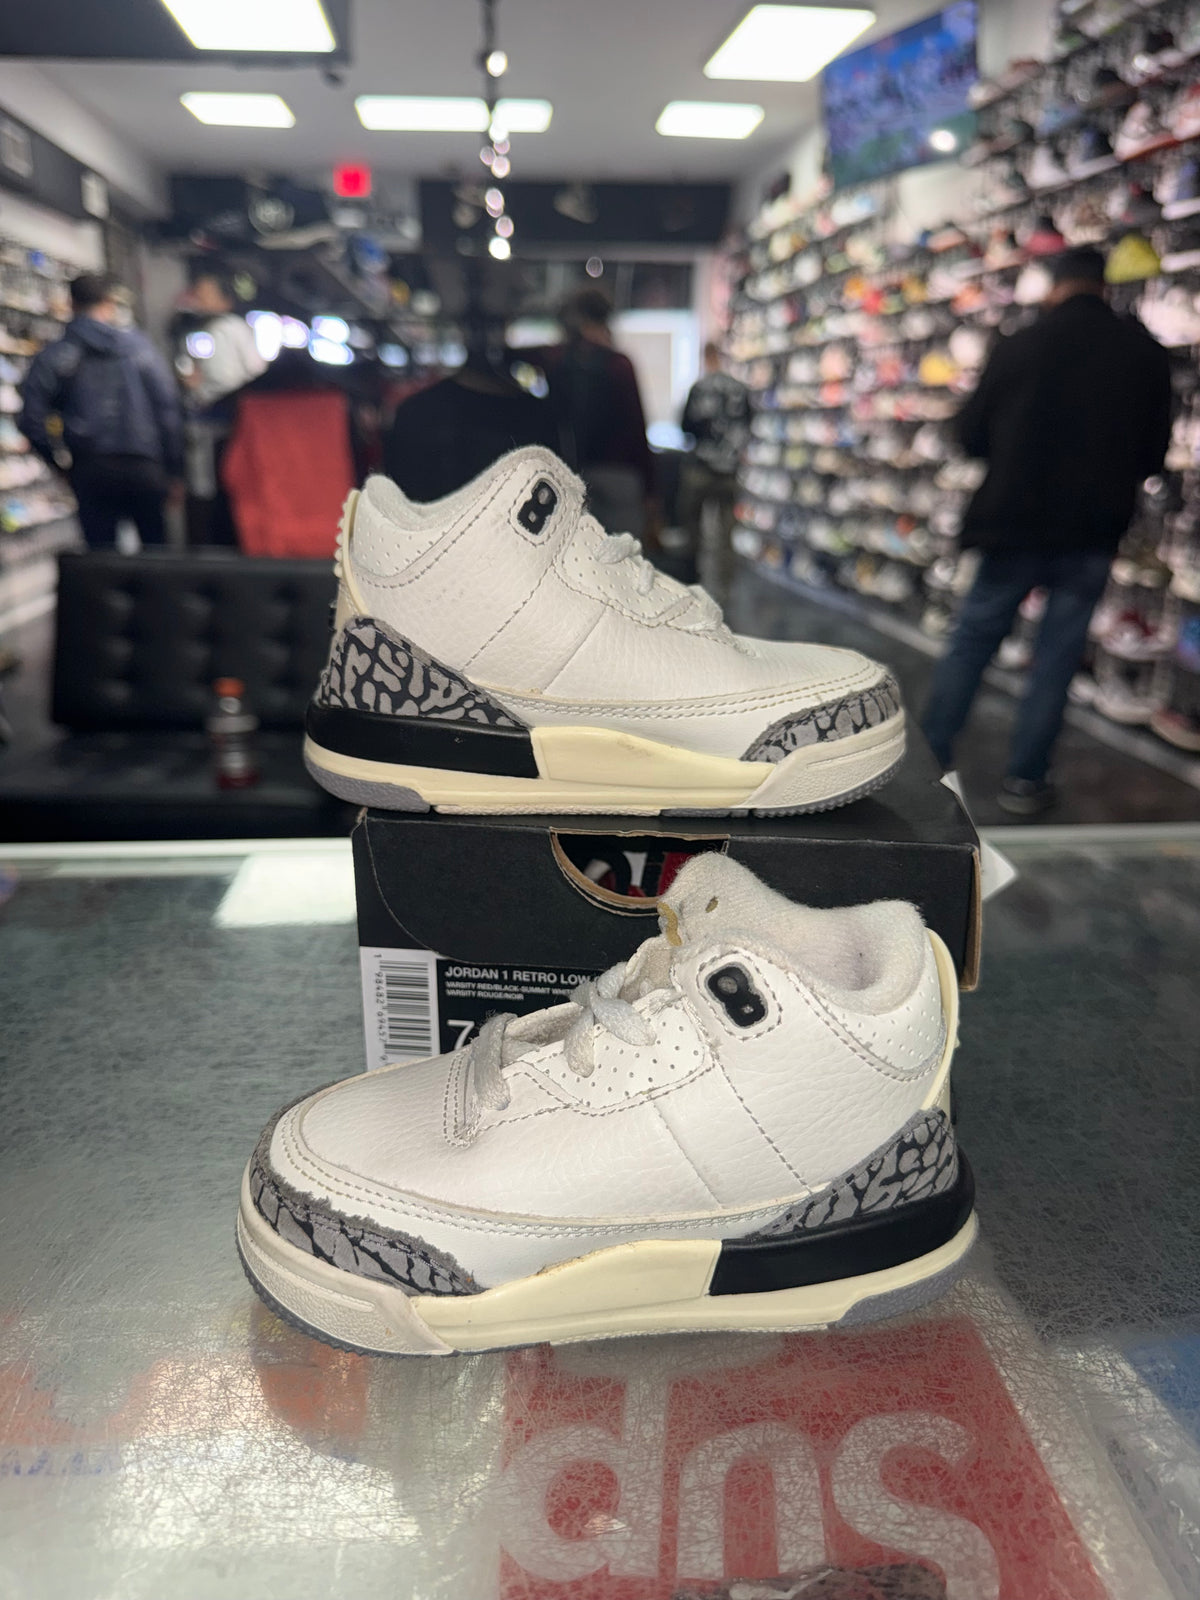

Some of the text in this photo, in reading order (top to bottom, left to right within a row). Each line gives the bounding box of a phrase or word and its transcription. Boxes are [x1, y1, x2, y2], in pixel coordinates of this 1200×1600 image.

[445, 966, 499, 980] JORDAN
[502, 970, 508, 980] 1
[512, 970, 557, 984] RETRO
[560, 974, 591, 986] LOW
[446, 981, 476, 990] VARSITY
[446, 989, 476, 997] VARSITY
[447, 1019, 475, 1051] 7
